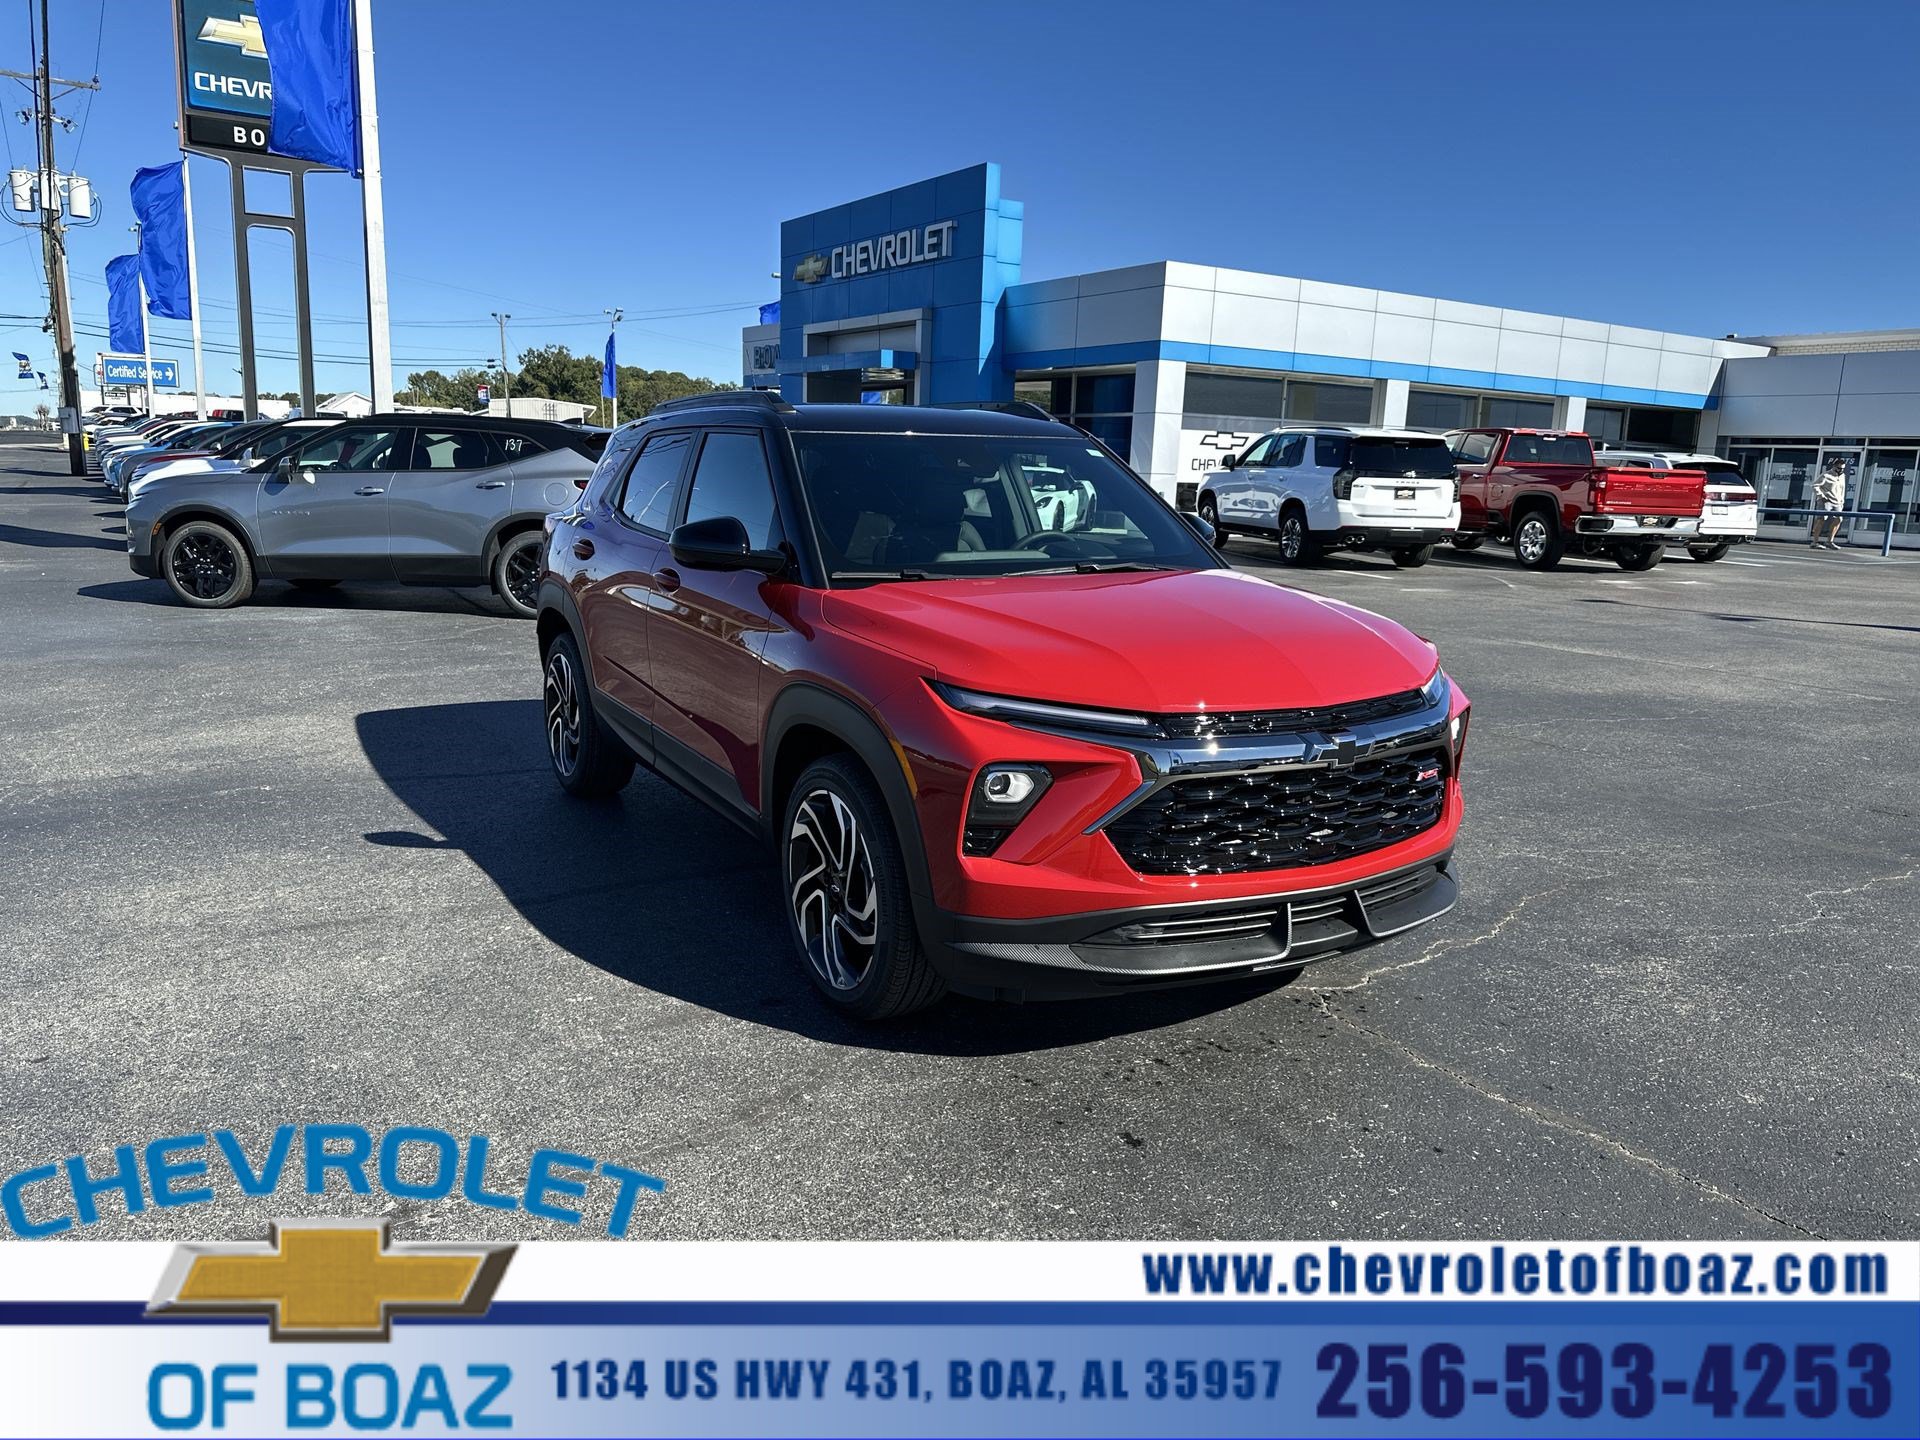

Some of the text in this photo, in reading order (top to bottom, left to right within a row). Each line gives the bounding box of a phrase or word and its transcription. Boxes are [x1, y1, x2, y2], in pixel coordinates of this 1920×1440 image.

[233, 126, 265, 147] BO
[831, 220, 955, 279] CHEVROLET
[107, 364, 163, 380] Certified Seice
[504, 438, 523, 452] 137
